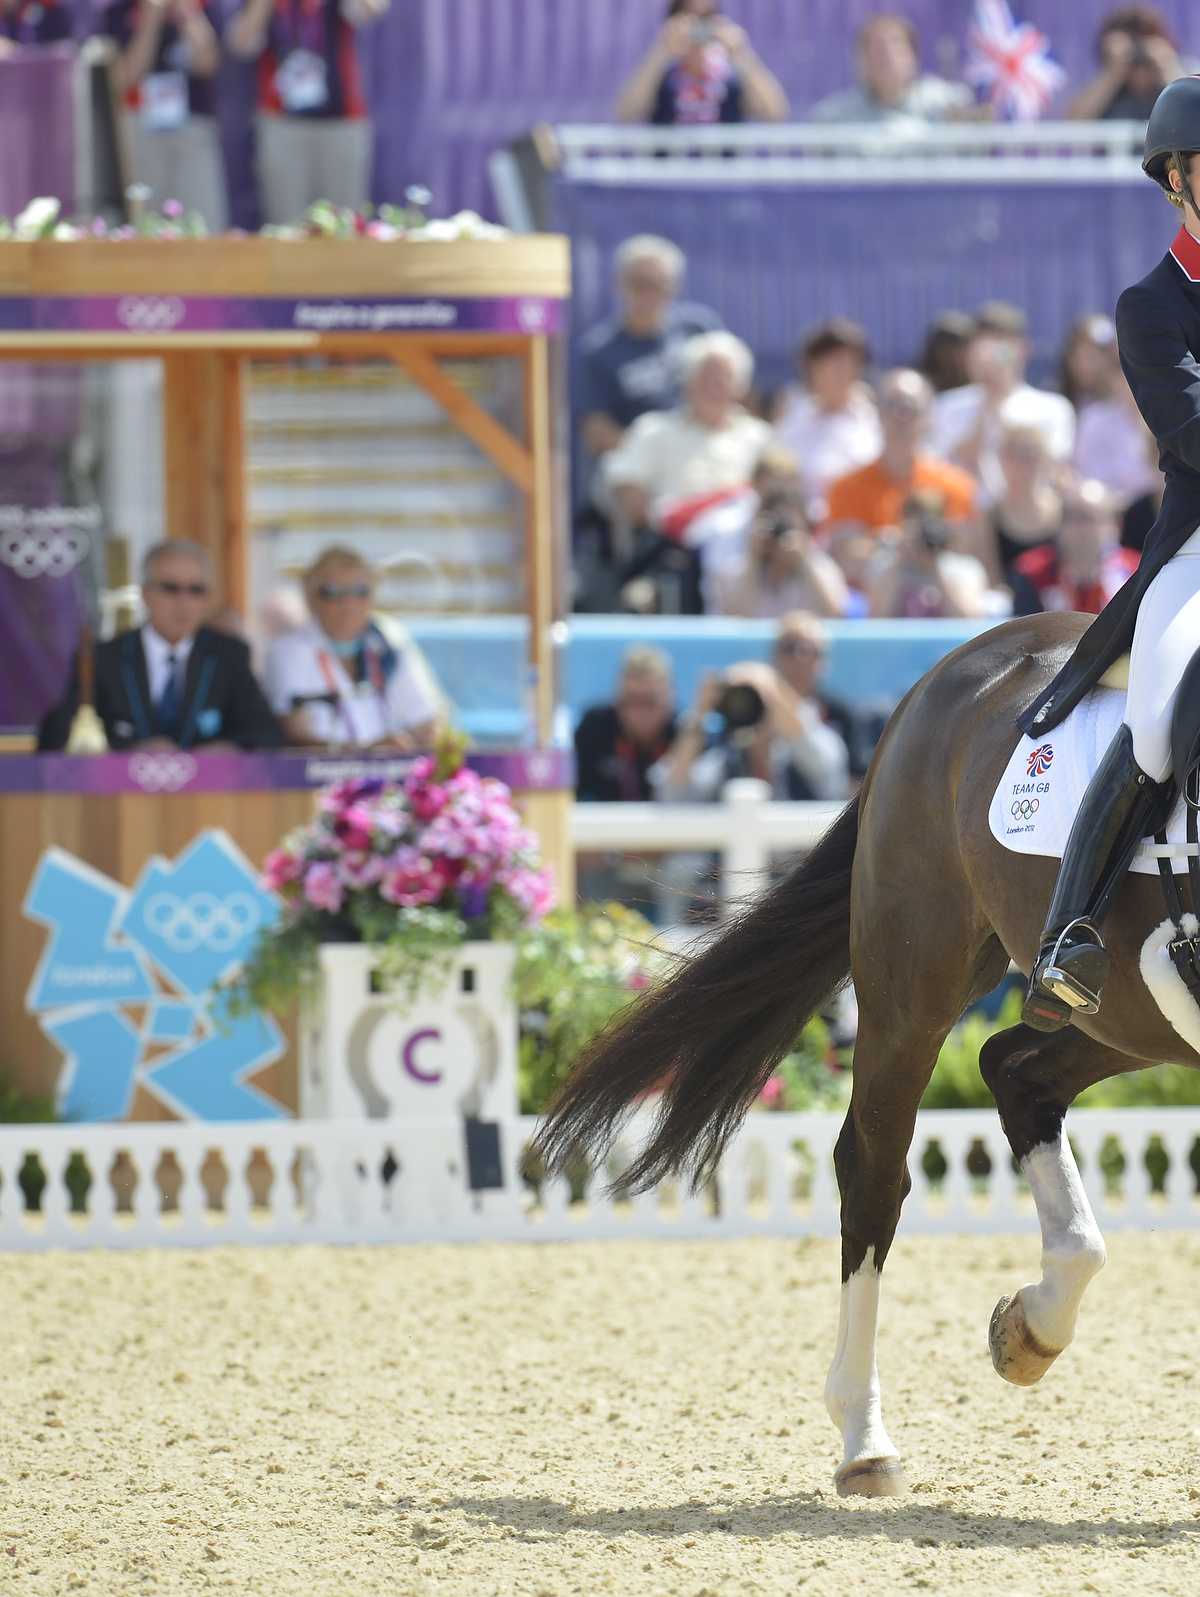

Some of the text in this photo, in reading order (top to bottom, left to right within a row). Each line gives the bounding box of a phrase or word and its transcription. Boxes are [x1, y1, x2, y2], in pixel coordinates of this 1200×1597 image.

[1012, 782, 1050, 795] TEAM GB
[1006, 825, 1024, 834] London
[399, 1027, 442, 1084] C
